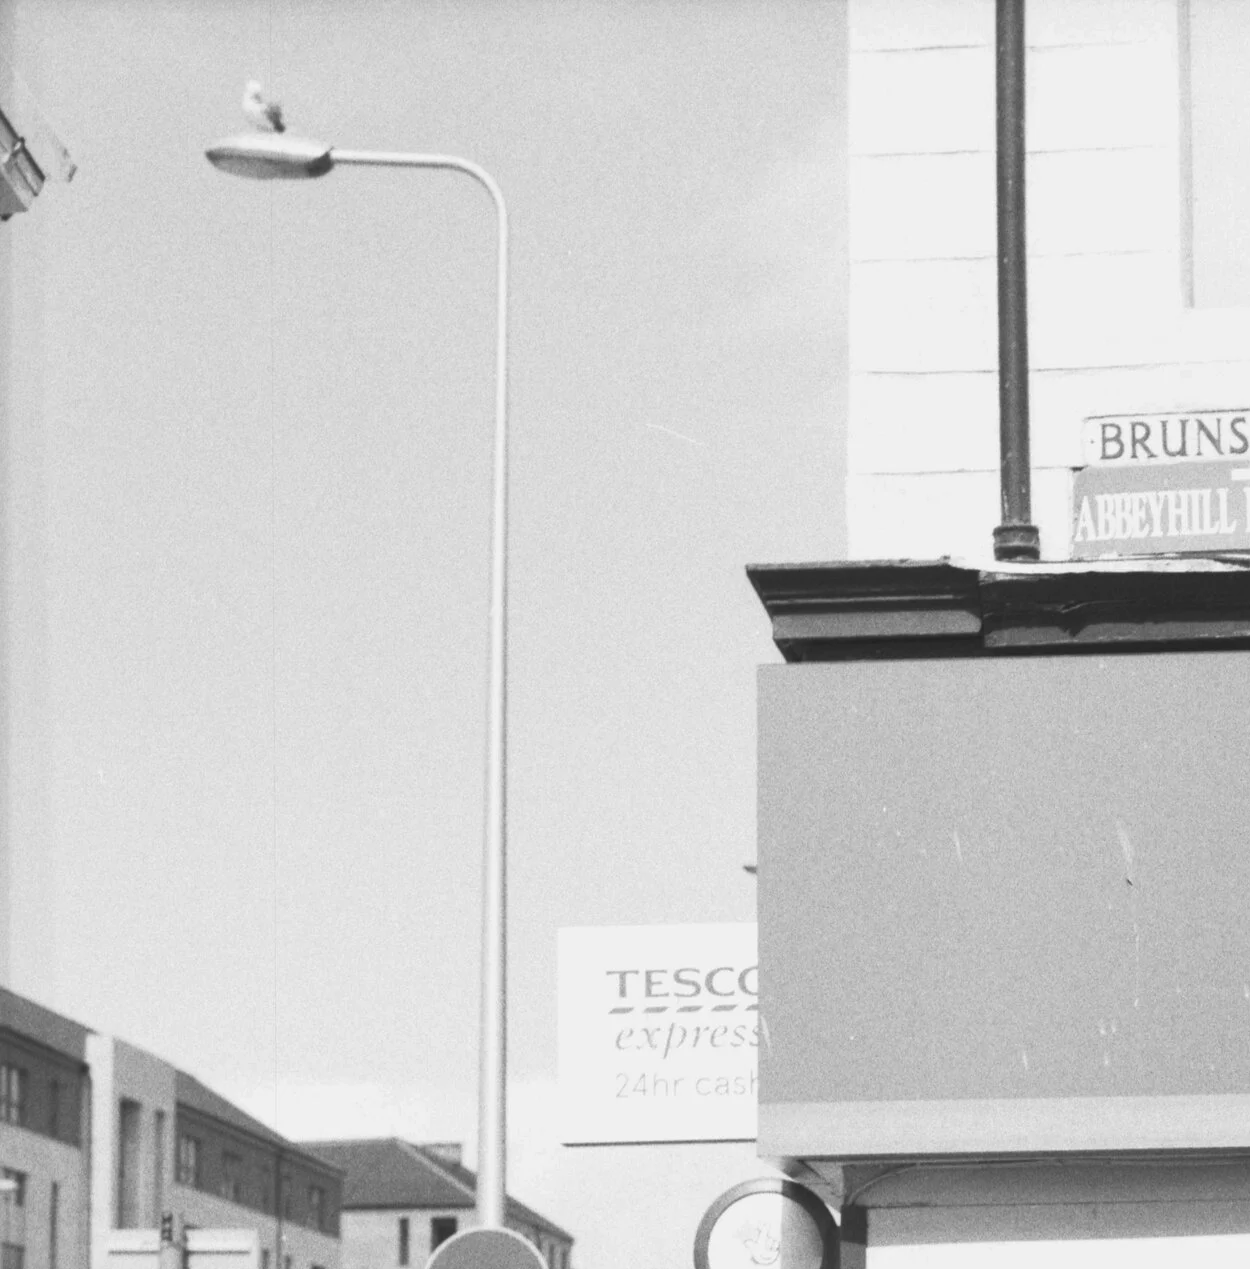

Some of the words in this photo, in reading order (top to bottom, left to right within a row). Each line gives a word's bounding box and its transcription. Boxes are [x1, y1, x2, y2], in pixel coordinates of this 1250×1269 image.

[1073, 487, 1236, 541] ABBEYHILL
[605, 966, 758, 998] TESCO
[615, 1072, 685, 1098] 24hr
